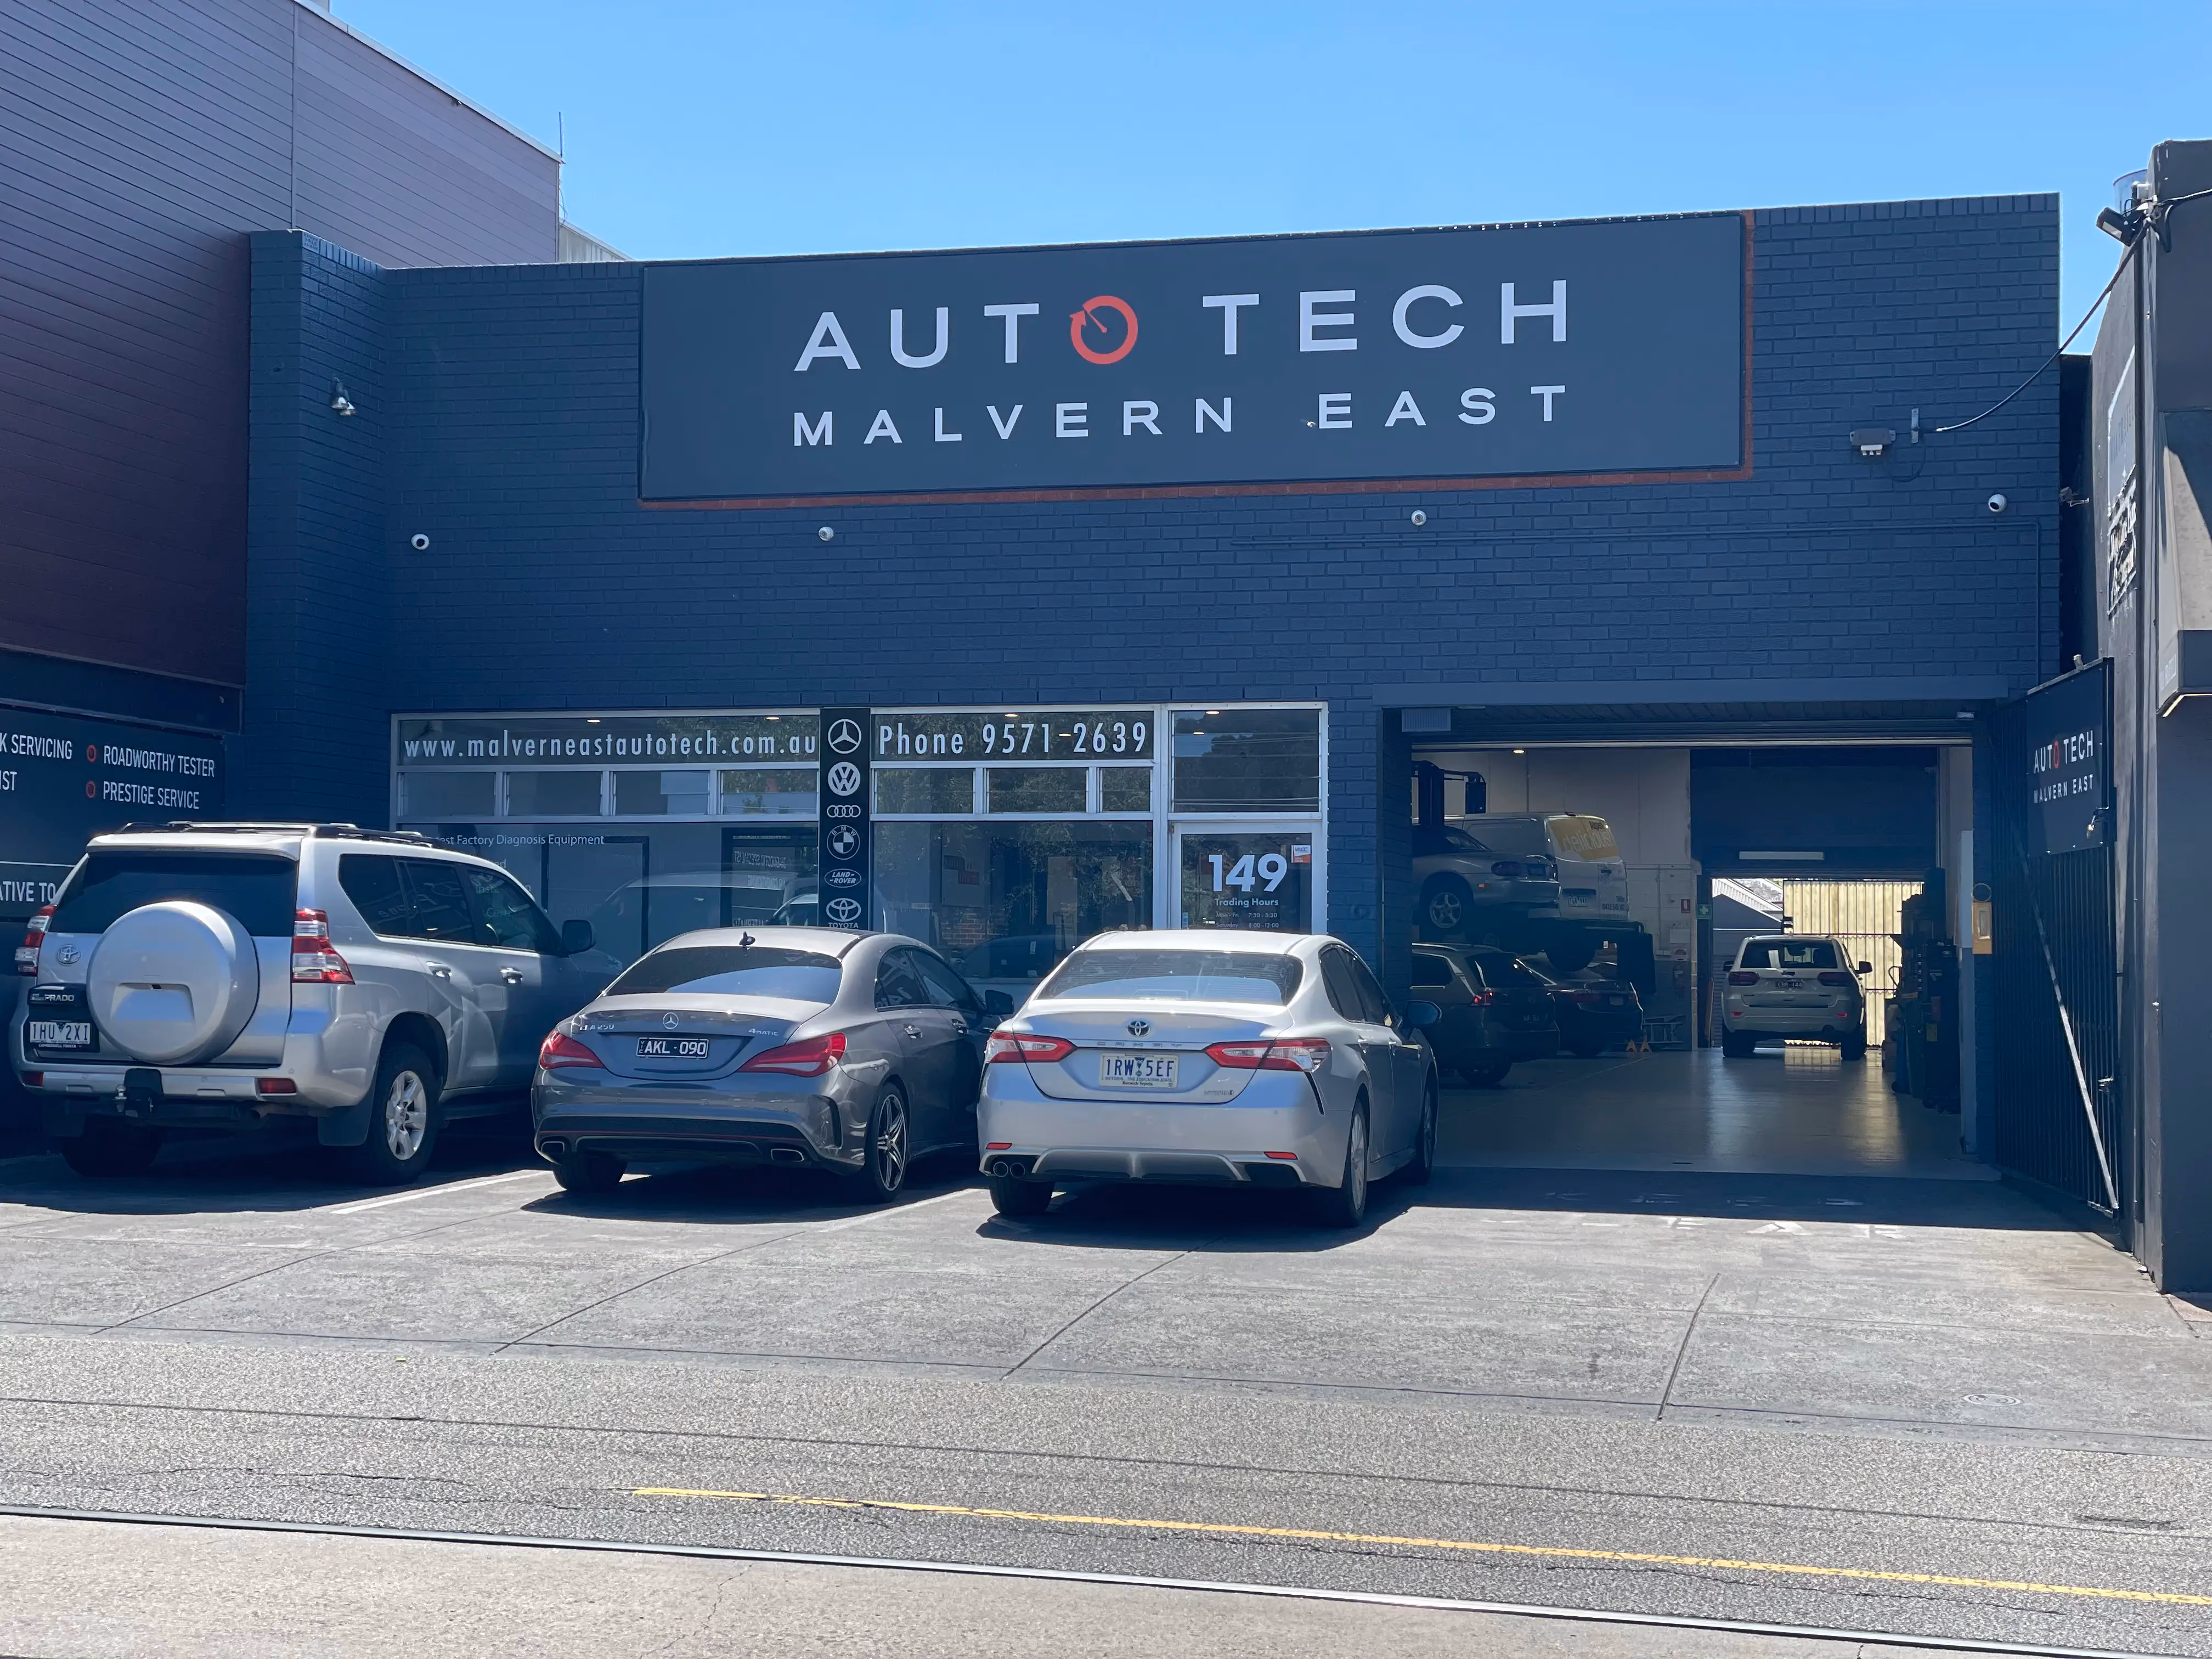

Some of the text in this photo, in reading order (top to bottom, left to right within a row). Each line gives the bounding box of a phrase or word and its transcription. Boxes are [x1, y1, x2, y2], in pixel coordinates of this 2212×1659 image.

[794, 280, 1567, 371] AUTO TECH
[793, 385, 1566, 447] MALVERN EAST
[11, 734, 72, 760] SERVICING
[405, 729, 816, 758] www.malverneastautotech.com.au
[879, 723, 964, 755] Phone
[2034, 730, 2094, 774] AUTO TECH
[104, 745, 215, 777] ROADWORTHY TESTER
[103, 781, 200, 809] PRESTIGE SERVICE
[2034, 774, 2094, 804] MALVERN EAST
[457, 834, 494, 847] Factory
[496, 834, 546, 846] Diagnosis
[548, 834, 605, 847] Equipment
[832, 825, 857, 837] BMW
[1209, 853, 1288, 892] 149
[38, 882, 56, 903] TO
[1215, 898, 1279, 908] Trading Hours
[44, 994, 75, 1002] PRADO
[32, 1024, 88, 1041] 1HU 2XI
[748, 1028, 779, 1037] 4MATIC
[1107, 1059, 1175, 1077] 1RW 5EF
